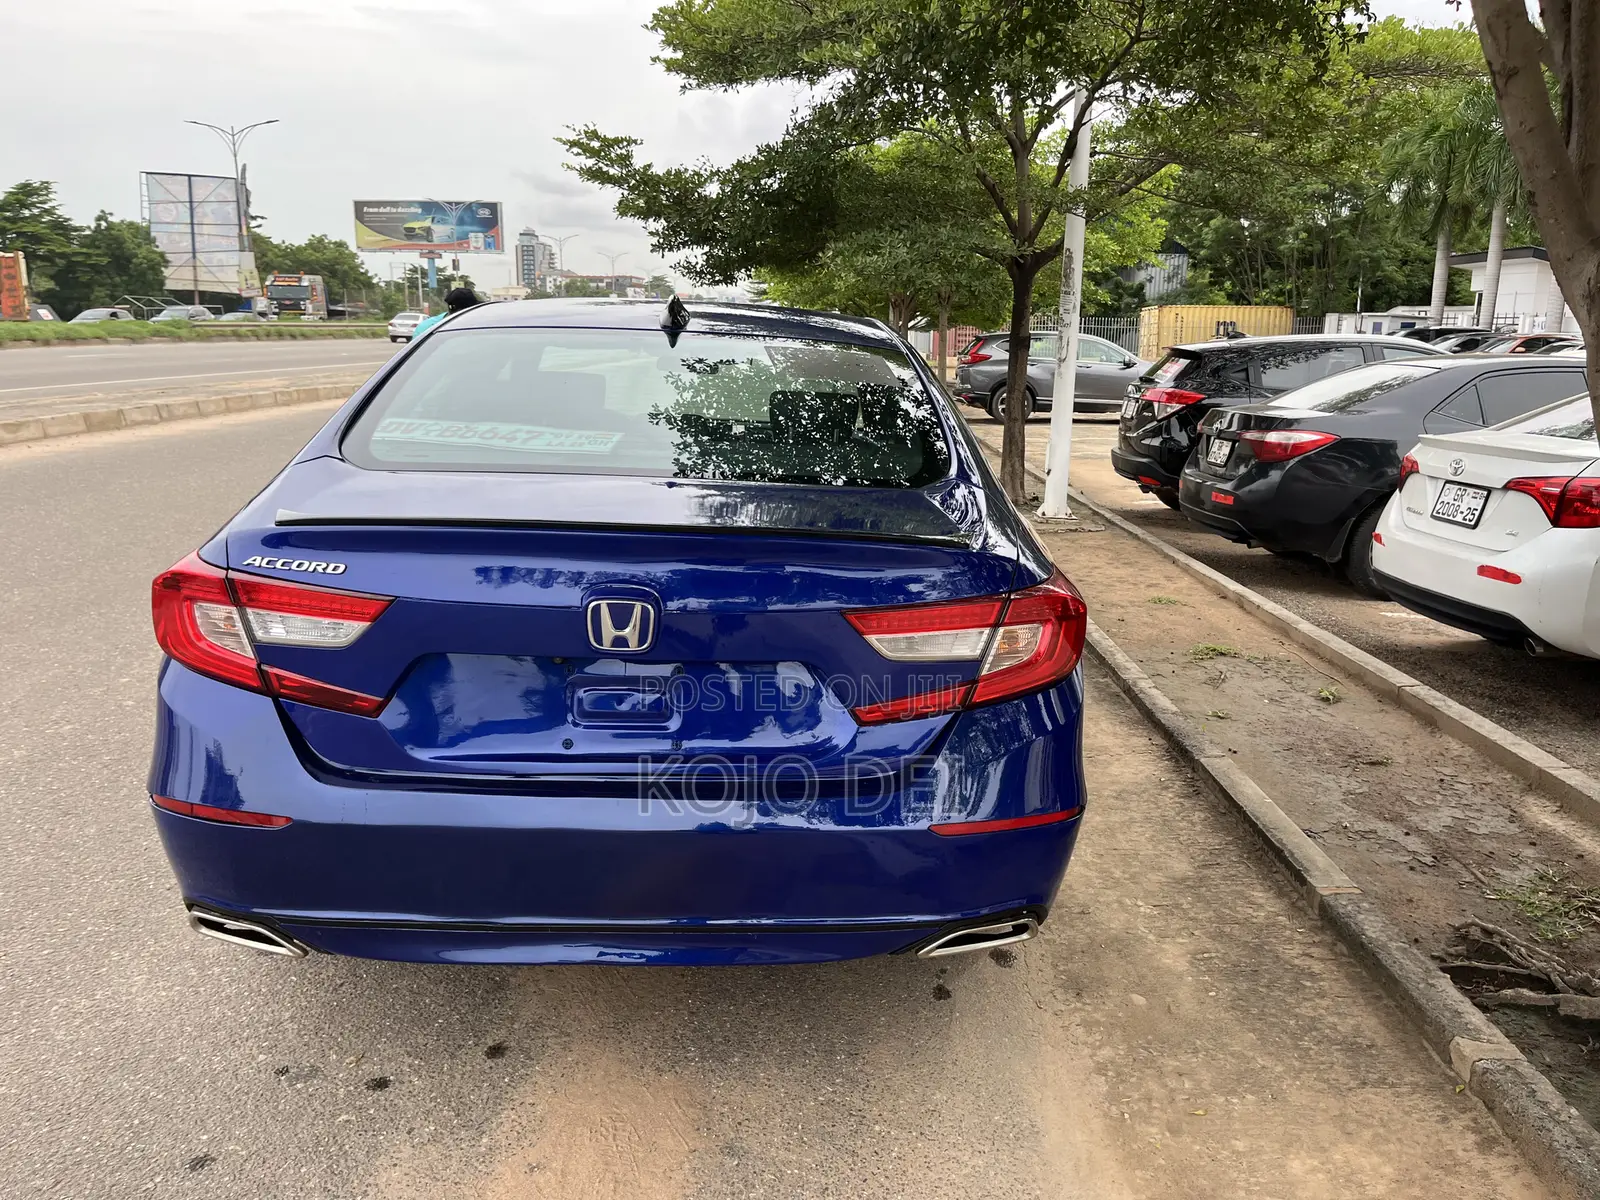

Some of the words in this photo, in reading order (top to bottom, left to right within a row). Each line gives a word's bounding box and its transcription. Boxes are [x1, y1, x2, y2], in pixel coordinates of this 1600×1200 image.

[1453, 487, 1467, 503] GR
[1435, 500, 1478, 523] 2008-25
[242, 555, 347, 575] ACCORD
